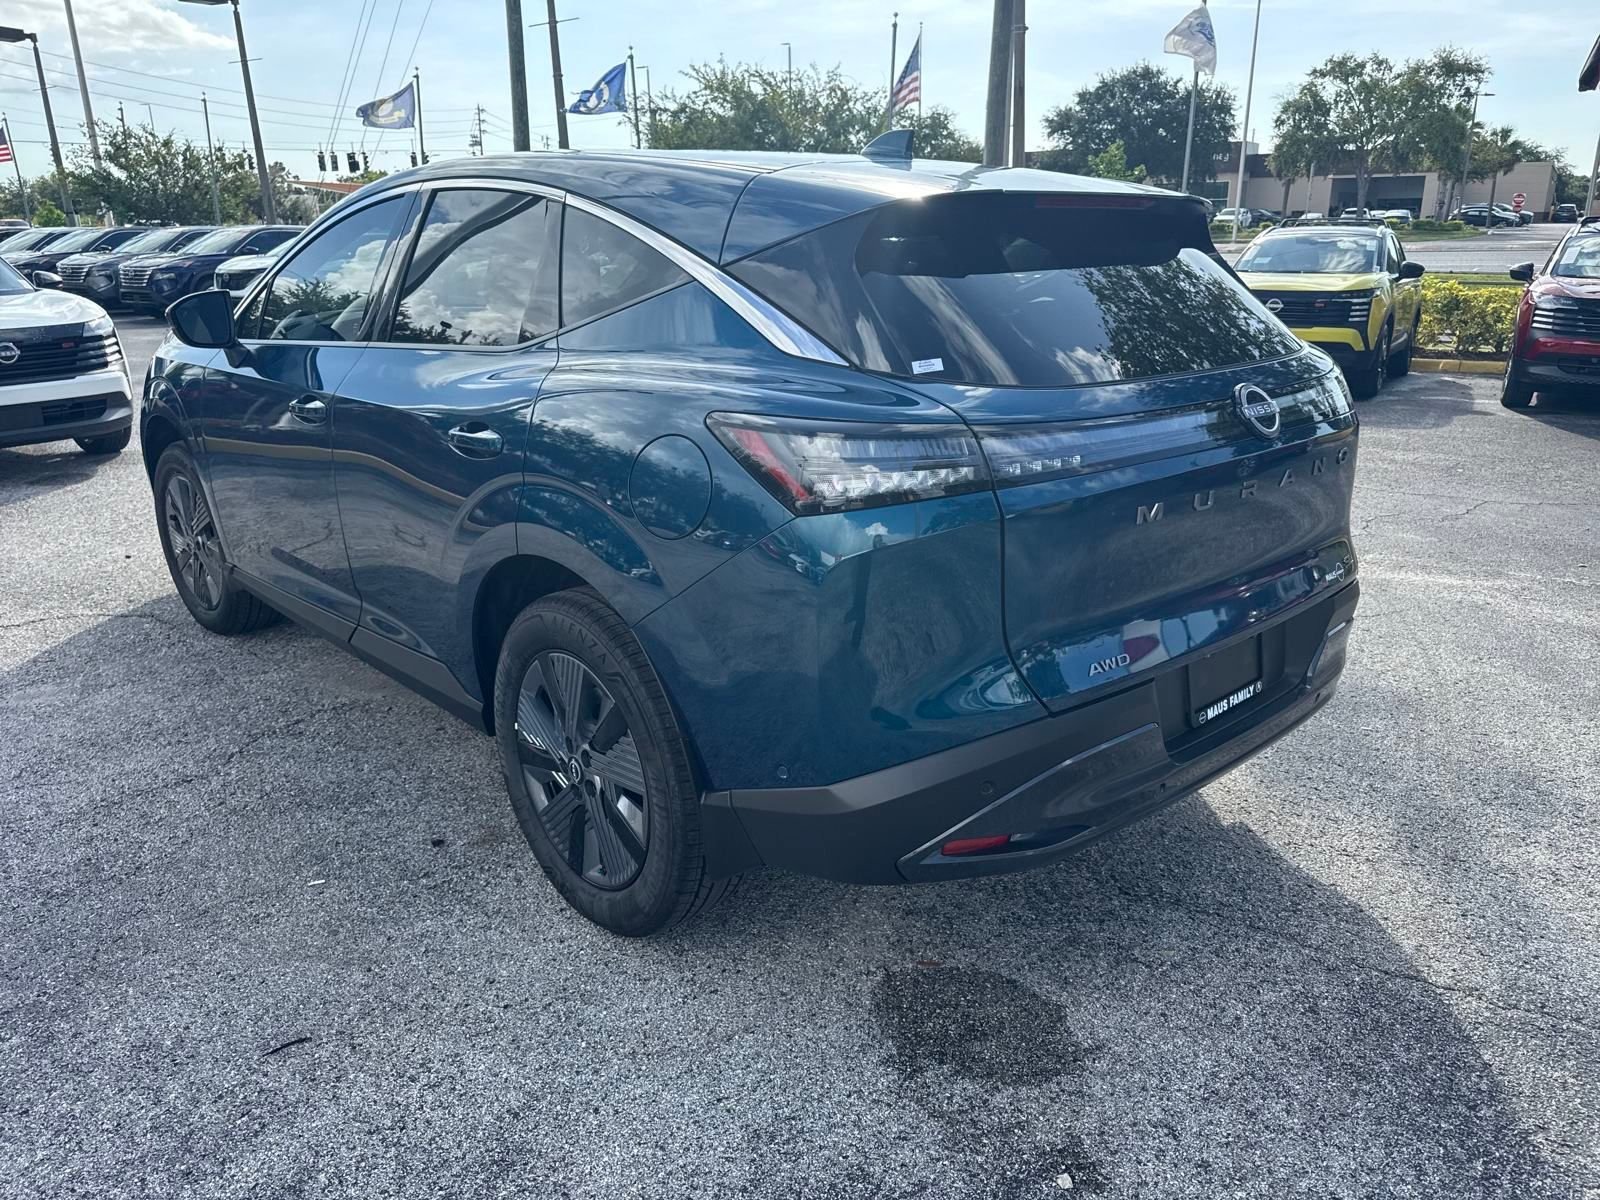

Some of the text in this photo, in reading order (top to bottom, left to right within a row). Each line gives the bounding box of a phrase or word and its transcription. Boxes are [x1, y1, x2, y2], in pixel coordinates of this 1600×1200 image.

[1136, 447, 1350, 525] MURANO
[1088, 653, 1130, 677] AWD
[1207, 684, 1255, 720] MAUS FAMILY
